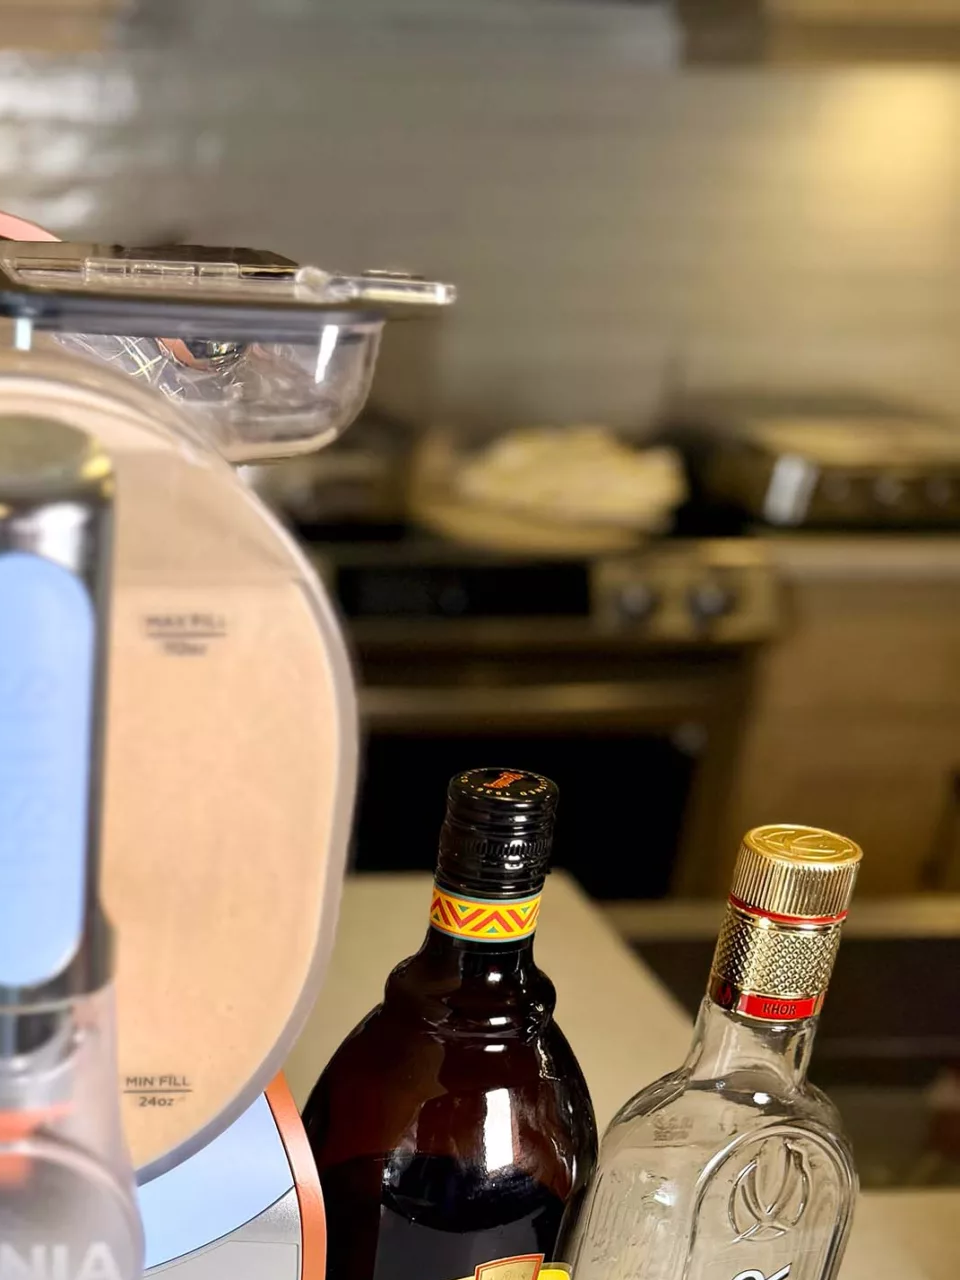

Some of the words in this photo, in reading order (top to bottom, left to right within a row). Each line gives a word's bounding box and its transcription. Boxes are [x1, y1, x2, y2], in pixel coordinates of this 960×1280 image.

[125, 1076, 155, 1088] MIN
[158, 1075, 192, 1087] FILL
[138, 1096, 175, 1108] 24oz
